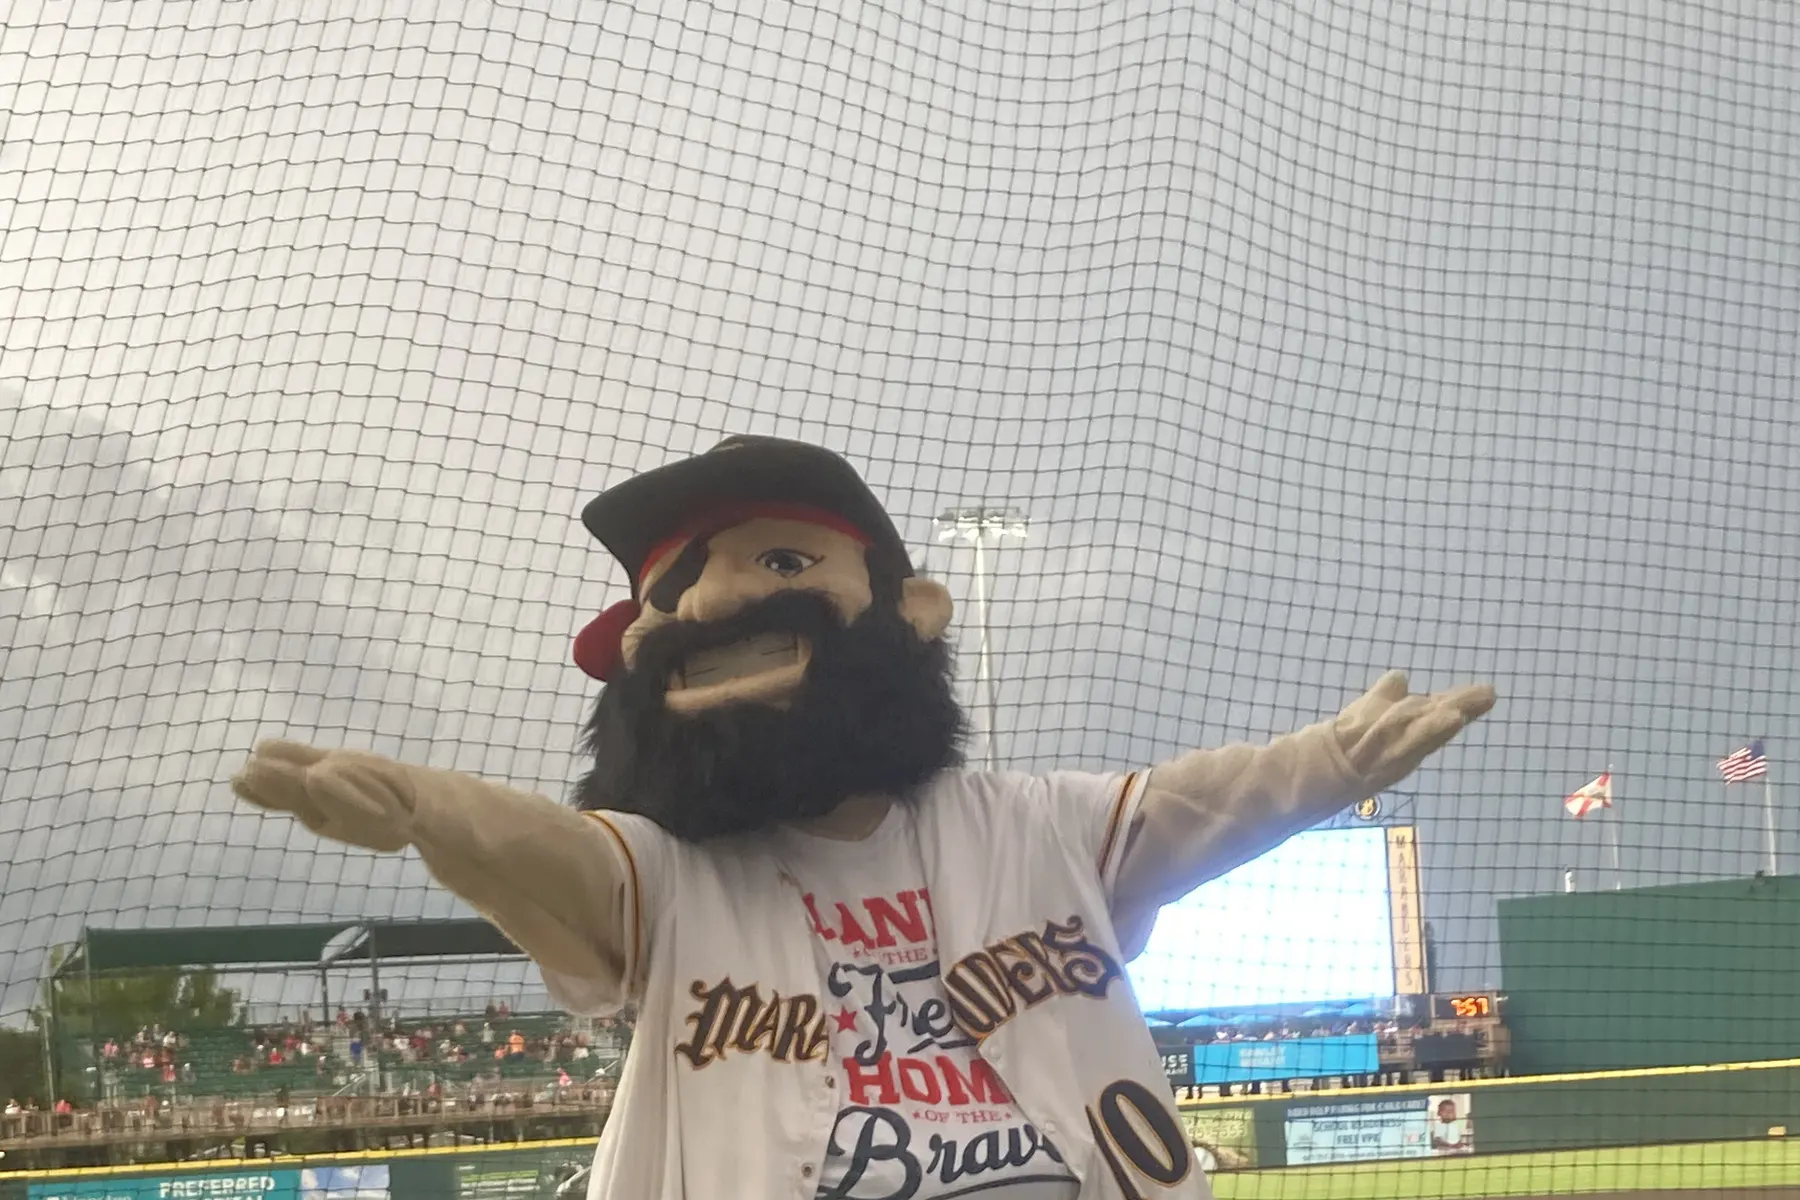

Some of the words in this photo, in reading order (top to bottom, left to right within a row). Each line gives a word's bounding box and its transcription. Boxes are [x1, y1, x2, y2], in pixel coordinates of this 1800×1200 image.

[802, 887, 937, 950] LAN
[882, 949, 928, 965] THE
[828, 962, 956, 1067] Fre
[842, 1050, 1013, 1106] HOM
[925, 1109, 949, 1124] OF
[956, 1108, 1002, 1124] THE
[159, 1176, 276, 1199] PREFERRED
